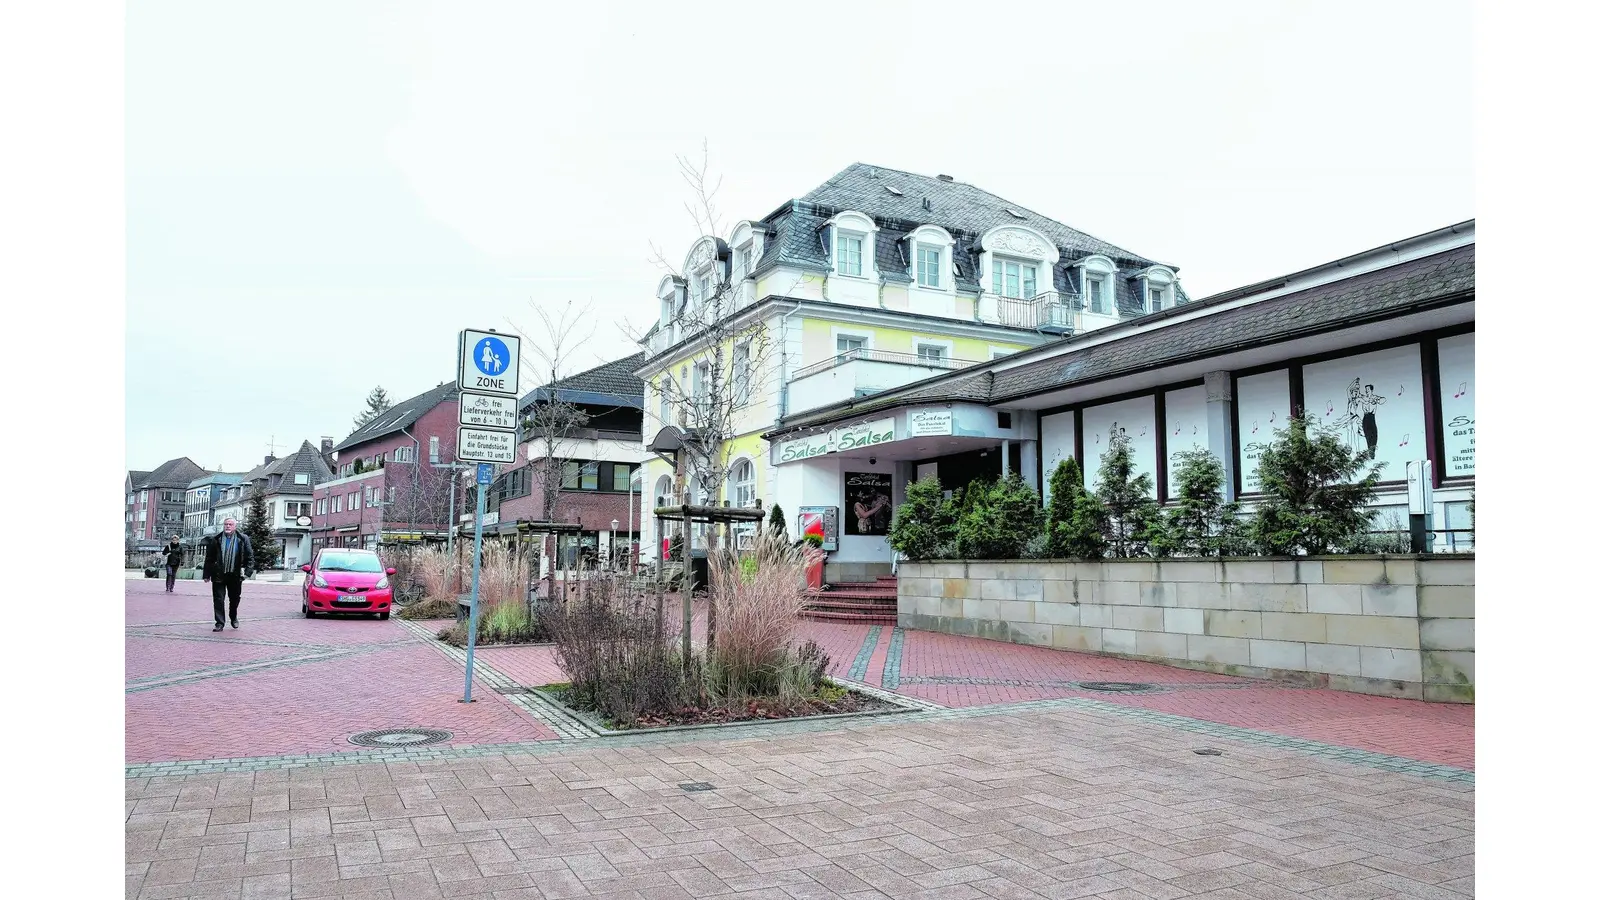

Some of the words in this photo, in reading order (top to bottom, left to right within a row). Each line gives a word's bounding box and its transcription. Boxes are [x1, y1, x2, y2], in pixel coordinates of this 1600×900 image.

[476, 376, 505, 389] ZONE
[492, 400, 502, 408] frei
[463, 406, 502, 417] Lieferverkehr
[483, 416, 487, 424] 6
[495, 417, 502, 425] 10
[503, 418, 508, 426] h
[467, 432, 488, 441] Einfahrt
[490, 434, 499, 442] frei
[838, 430, 894, 451] Salsa
[467, 441, 475, 449] die
[477, 442, 508, 451] Grundstücke
[495, 452, 504, 460] und
[781, 444, 827, 462] Salsa
[846, 476, 891, 487] Salsa
